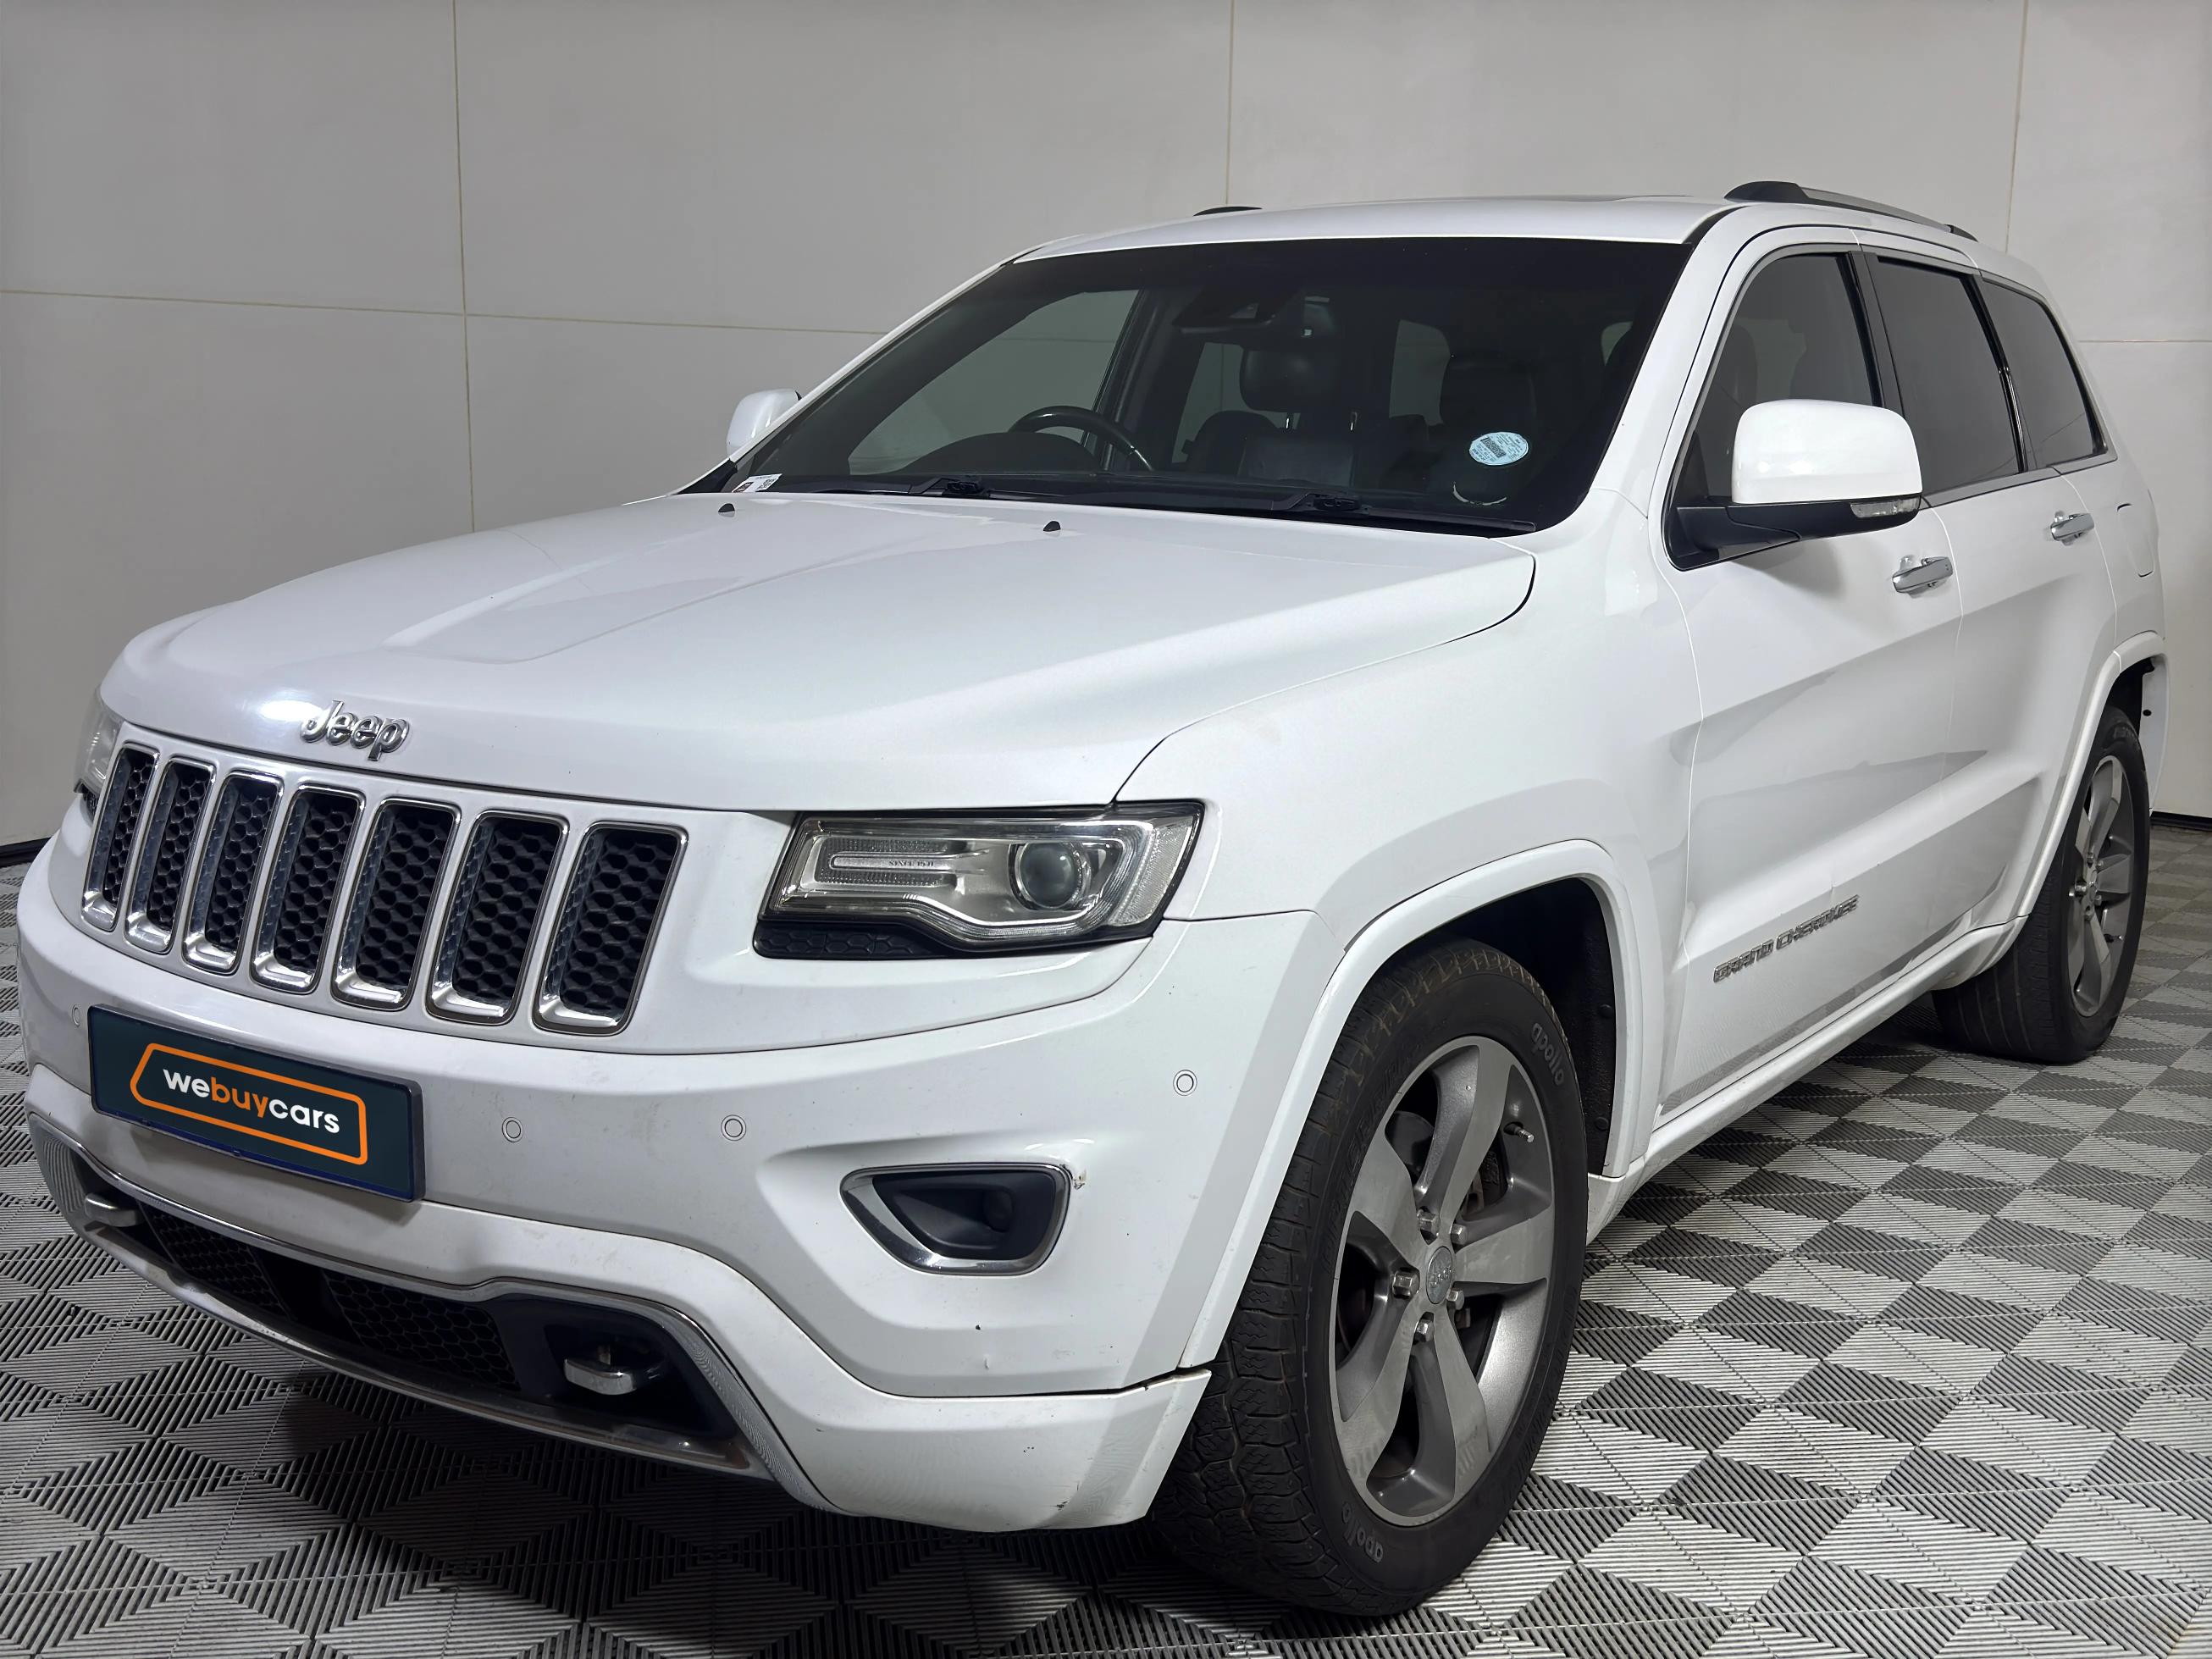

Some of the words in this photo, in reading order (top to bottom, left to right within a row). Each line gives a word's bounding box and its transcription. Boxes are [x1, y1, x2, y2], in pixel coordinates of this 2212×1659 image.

[300, 700, 410, 761] Jeep
[1531, 1022, 1565, 1086] apollo
[162, 1069, 340, 1134] webuycars
[1341, 1501, 1384, 1563] apollo
